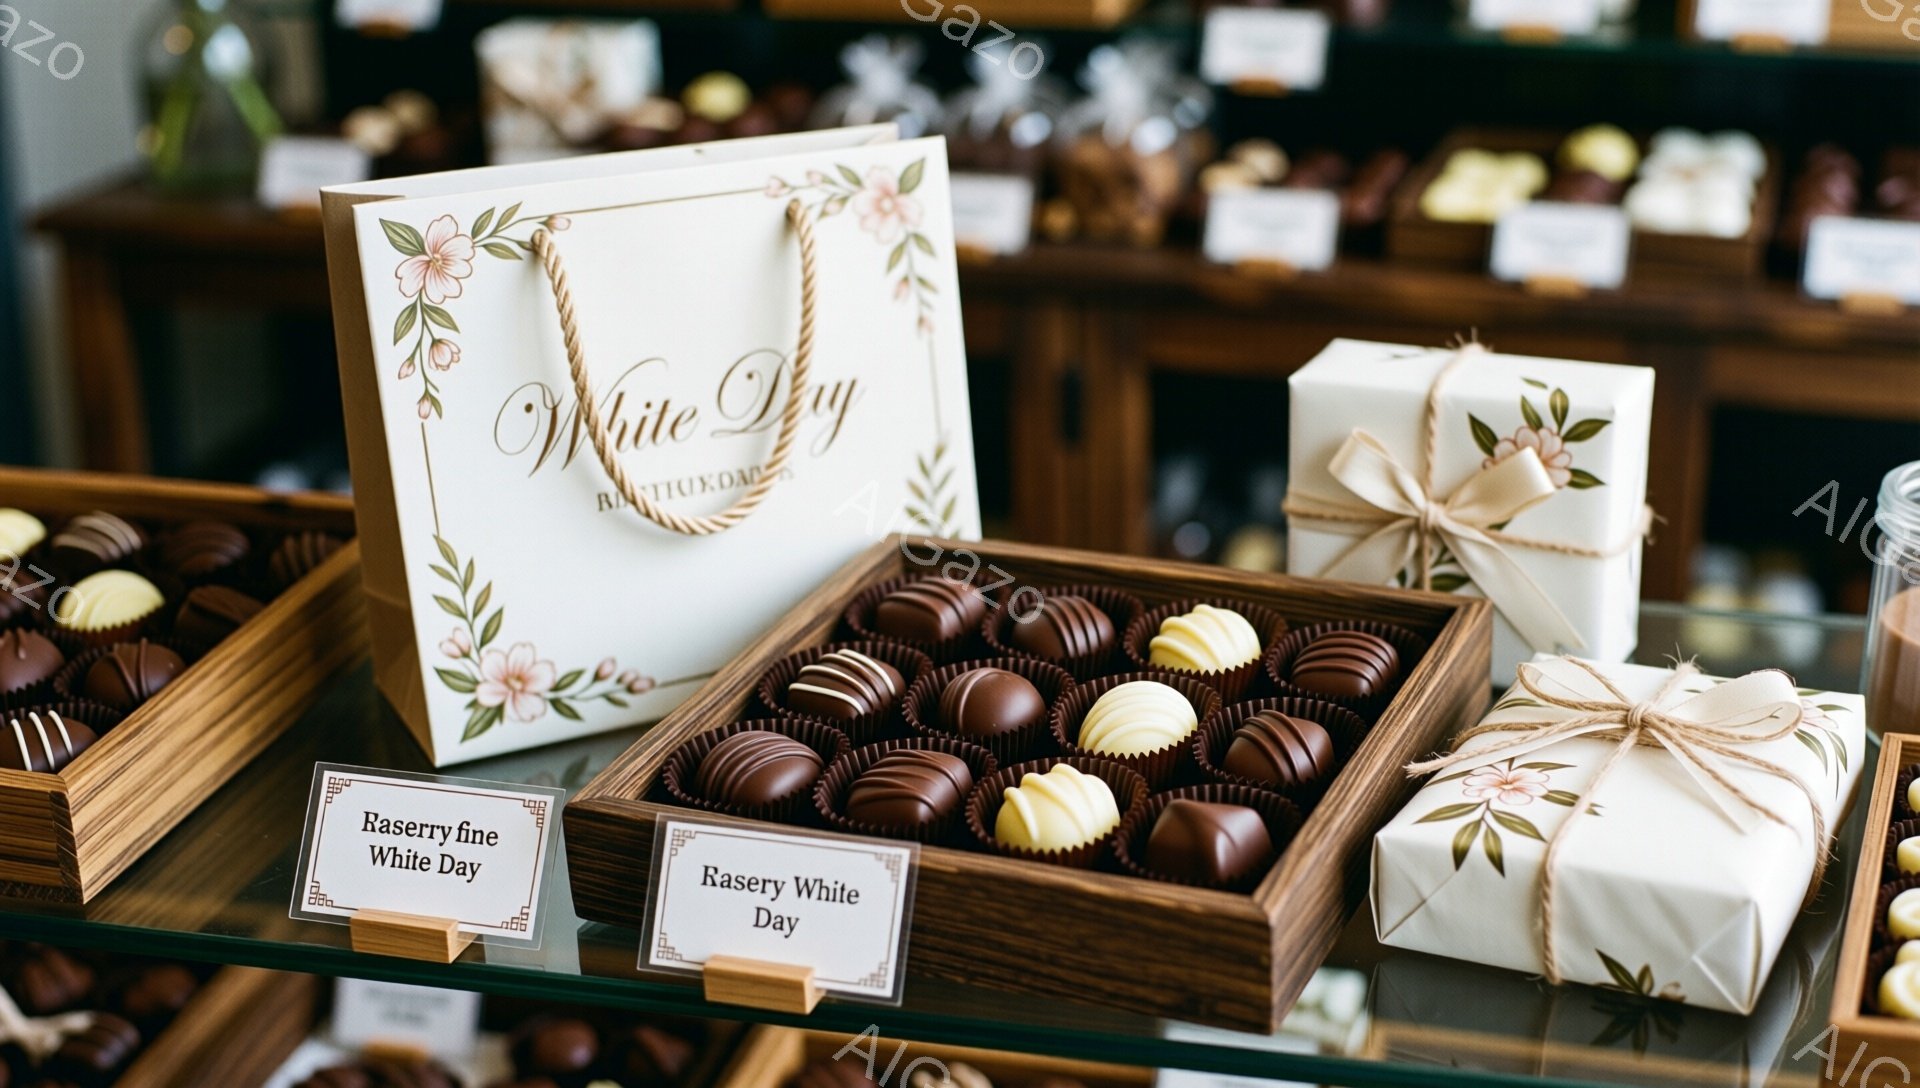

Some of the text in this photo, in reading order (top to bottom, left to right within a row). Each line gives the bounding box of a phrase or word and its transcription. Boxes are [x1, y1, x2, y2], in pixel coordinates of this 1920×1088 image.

[494, 357, 701, 479] White
[361, 811, 499, 847] Raserry fine
[369, 845, 482, 883] White Day
[700, 865, 860, 905] Rasery White
[753, 907, 800, 938] Day
